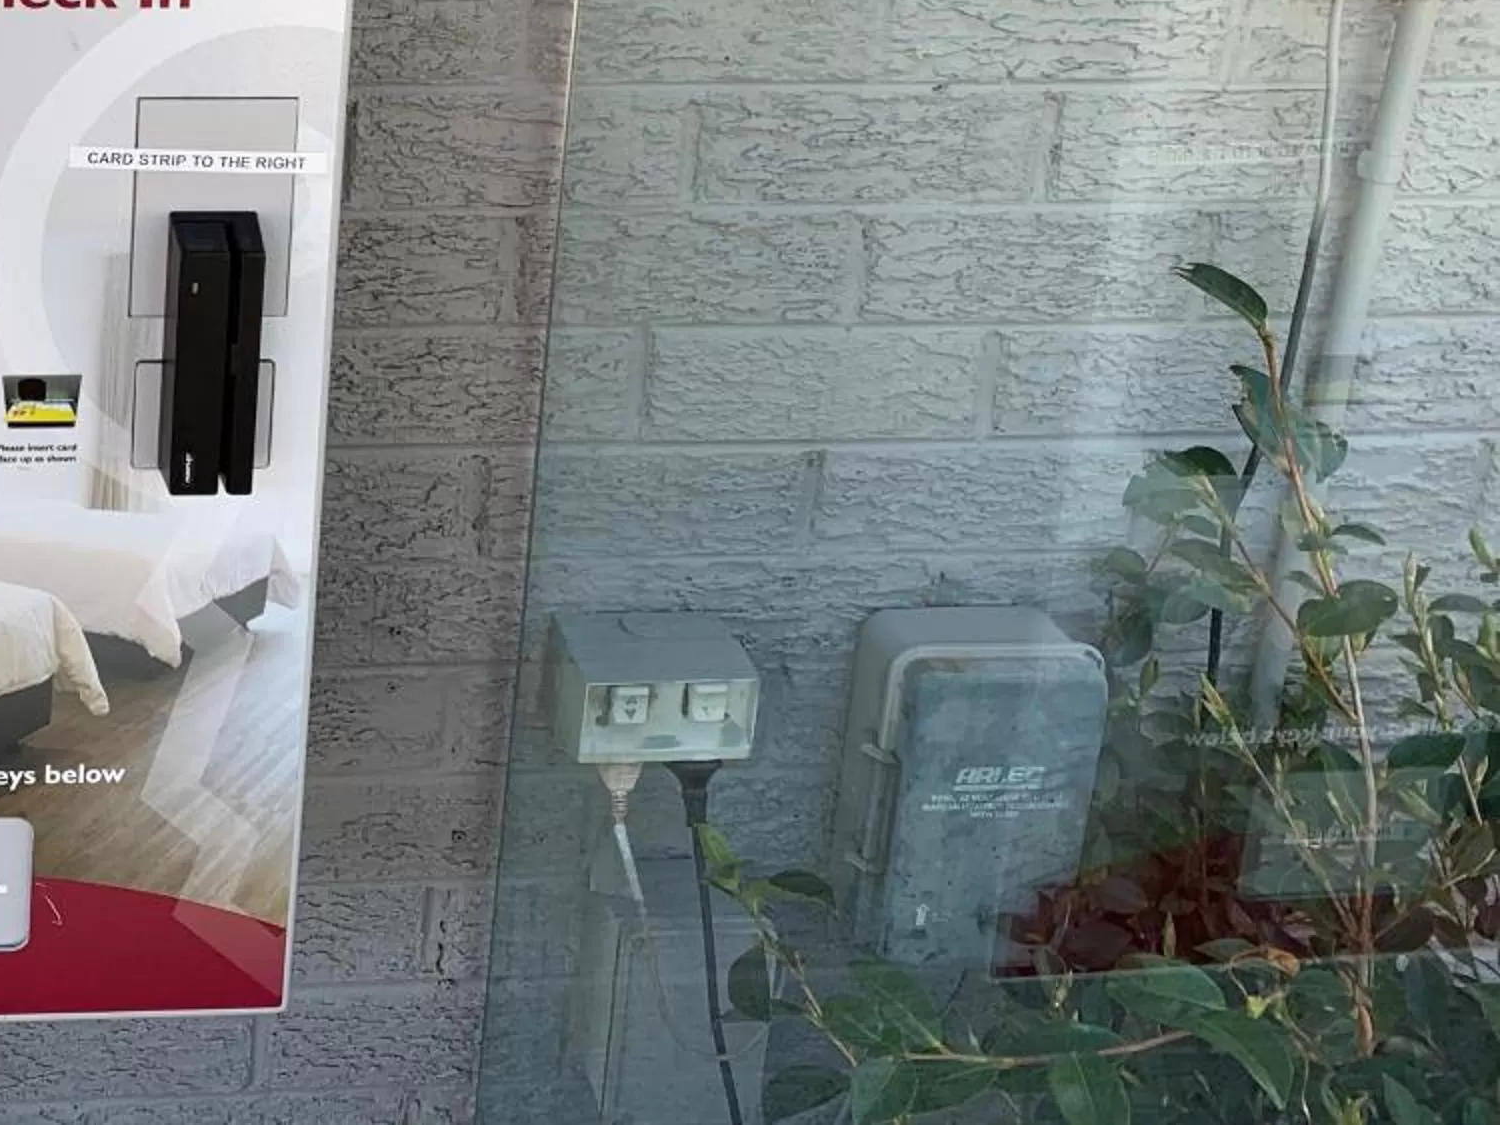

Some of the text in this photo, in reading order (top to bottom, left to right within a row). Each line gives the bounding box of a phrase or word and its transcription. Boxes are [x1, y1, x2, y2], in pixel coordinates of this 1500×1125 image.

[87, 151, 306, 170] CARD STRIP TO THE RIGHT
[27, 443, 55, 452] insert
[56, 443, 77, 452] card
[20, 455, 32, 464] up
[46, 454, 77, 463] shown
[44, 763, 126, 785] below
[955, 766, 1048, 784] ARLEC
